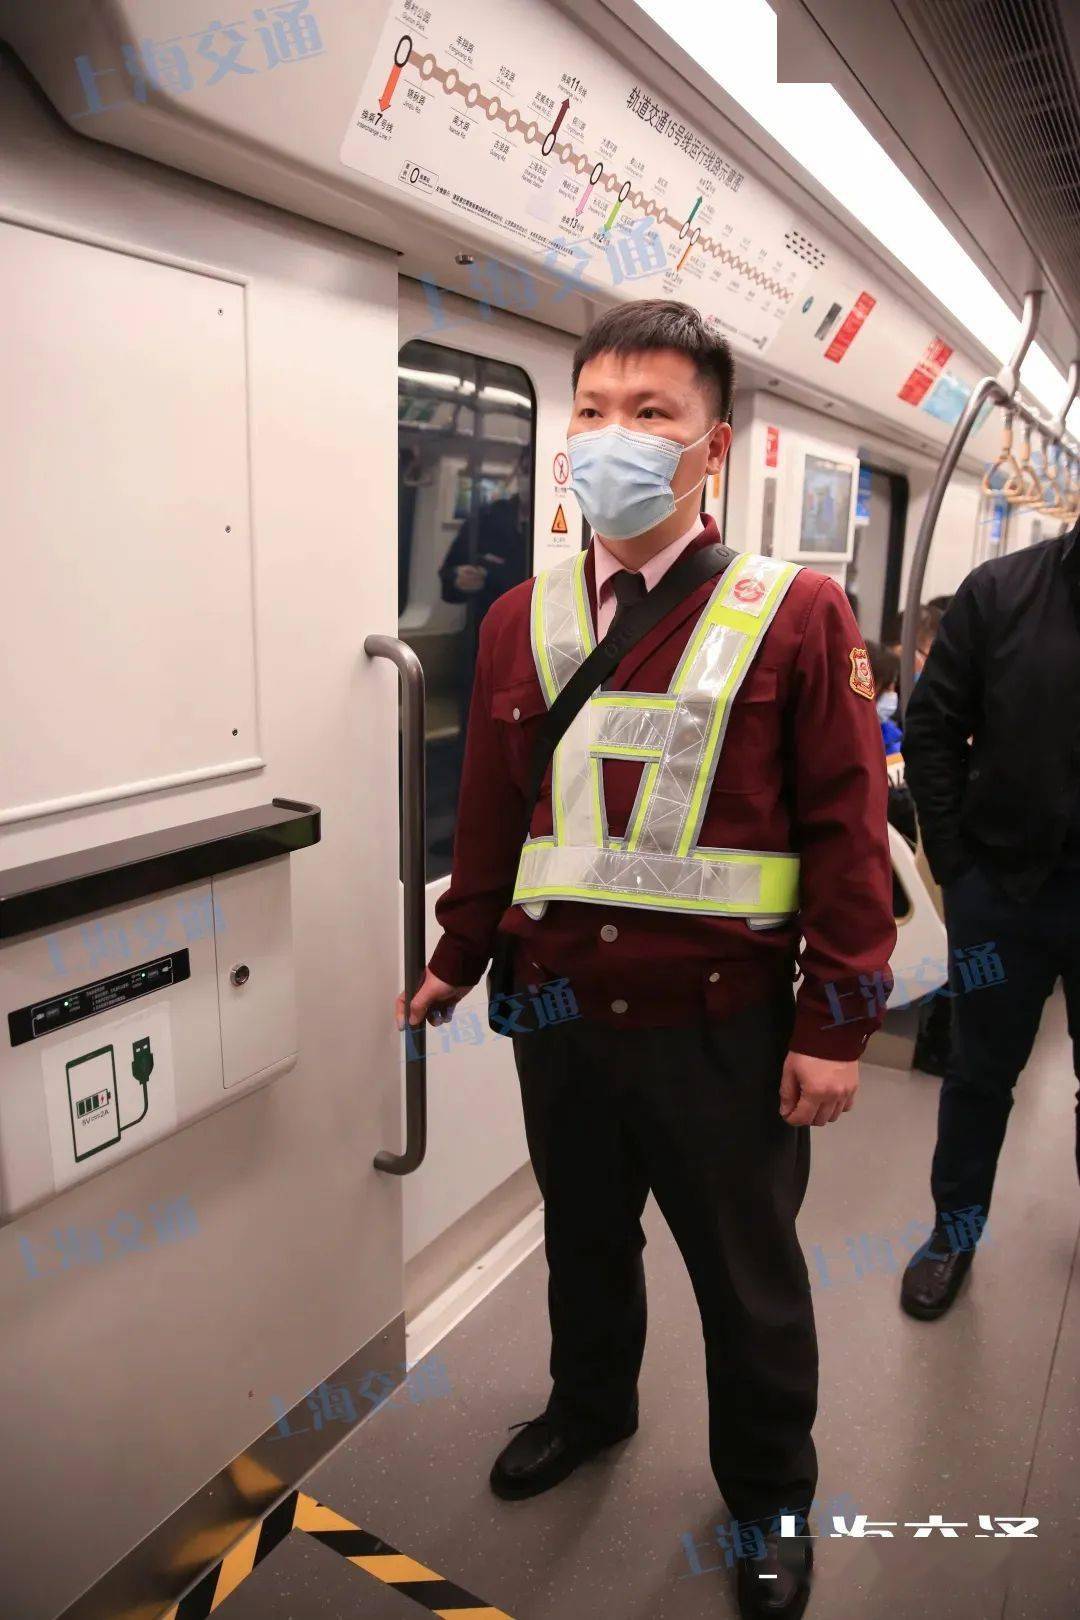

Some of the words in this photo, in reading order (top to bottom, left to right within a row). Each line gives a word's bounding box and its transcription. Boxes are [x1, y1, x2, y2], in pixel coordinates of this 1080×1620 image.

[626, 86, 745, 192] 轨道交通15号线运行线路示意图
